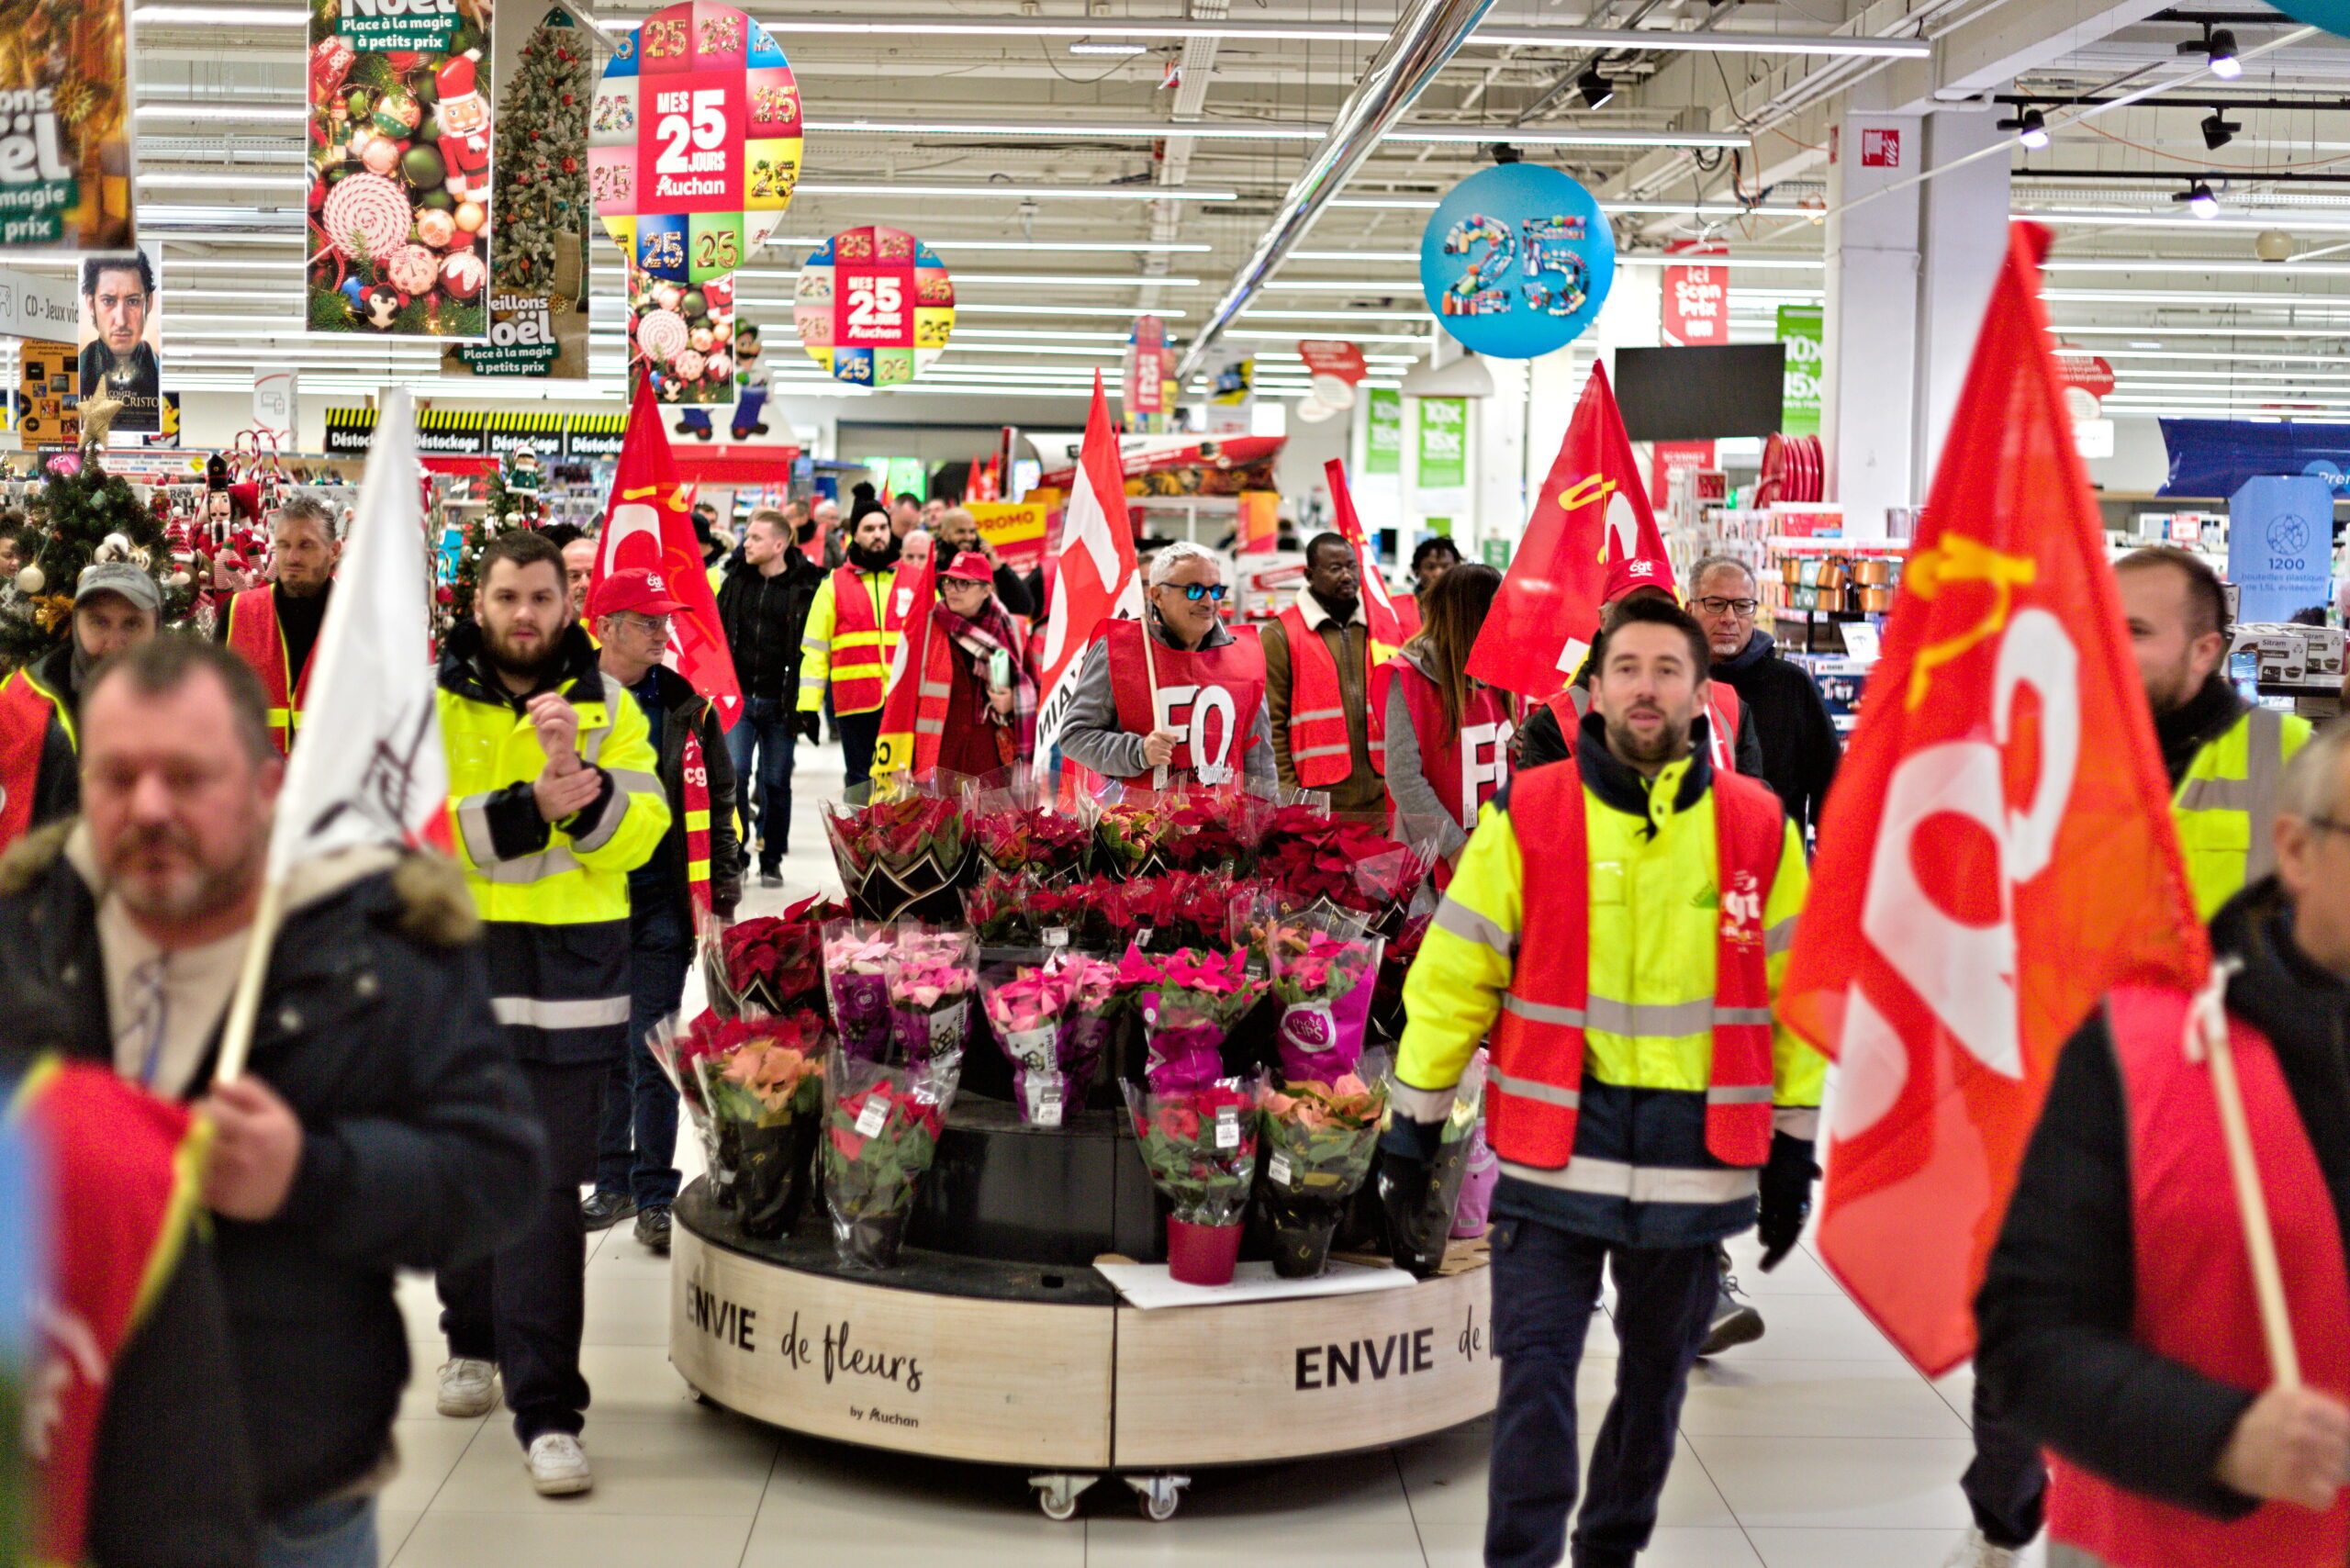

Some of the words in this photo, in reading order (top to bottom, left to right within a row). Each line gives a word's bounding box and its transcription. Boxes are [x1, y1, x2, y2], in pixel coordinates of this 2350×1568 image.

[341, 18, 379, 31] Place
[382, 17, 390, 29] à
[393, 17, 407, 28] la
[409, 15, 453, 30] magie
[698, 17, 739, 53] 25
[357, 34, 366, 47] à
[369, 34, 410, 50] petits
[413, 34, 442, 50] prix
[645, 20, 686, 57] 25
[593, 95, 633, 131] 25
[657, 92, 688, 113] MES
[754, 85, 797, 123] 25
[656, 89, 726, 174] 25
[688, 151, 725, 172] JOURS
[593, 164, 632, 202] 25
[655, 174, 725, 196] Auchan
[751, 160, 796, 198] 25
[5, 216, 51, 241] prix
[643, 230, 684, 269] 25
[696, 230, 738, 268] 25
[839, 235, 871, 258] 25
[1442, 214, 1590, 316] 25
[847, 276, 902, 325] 25
[1674, 280, 1721, 299] Scan
[26, 295, 38, 317] CD
[46, 298, 65, 322] Jeux
[489, 295, 548, 310] eillons
[1678, 297, 1717, 317] Prix
[491, 310, 555, 347] oël
[847, 326, 901, 338] Auchan
[464, 349, 494, 359] Place
[496, 348, 503, 357] à
[505, 347, 517, 357] la
[519, 345, 553, 358] magie
[476, 362, 484, 372] à
[486, 361, 520, 375] petits
[521, 361, 544, 374] prix
[838, 357, 871, 380] 25
[414, 432, 479, 453] Déstockage
[2268, 557, 2305, 570] 1200
[687, 1280, 756, 1353] ENVIE
[780, 1310, 811, 1371] de
[822, 1320, 923, 1394] fleurs
[1295, 1327, 1434, 1392] ENVIE
[1458, 1304, 1483, 1362] de
[850, 1406, 864, 1421] by
[868, 1406, 919, 1428] Auchan
